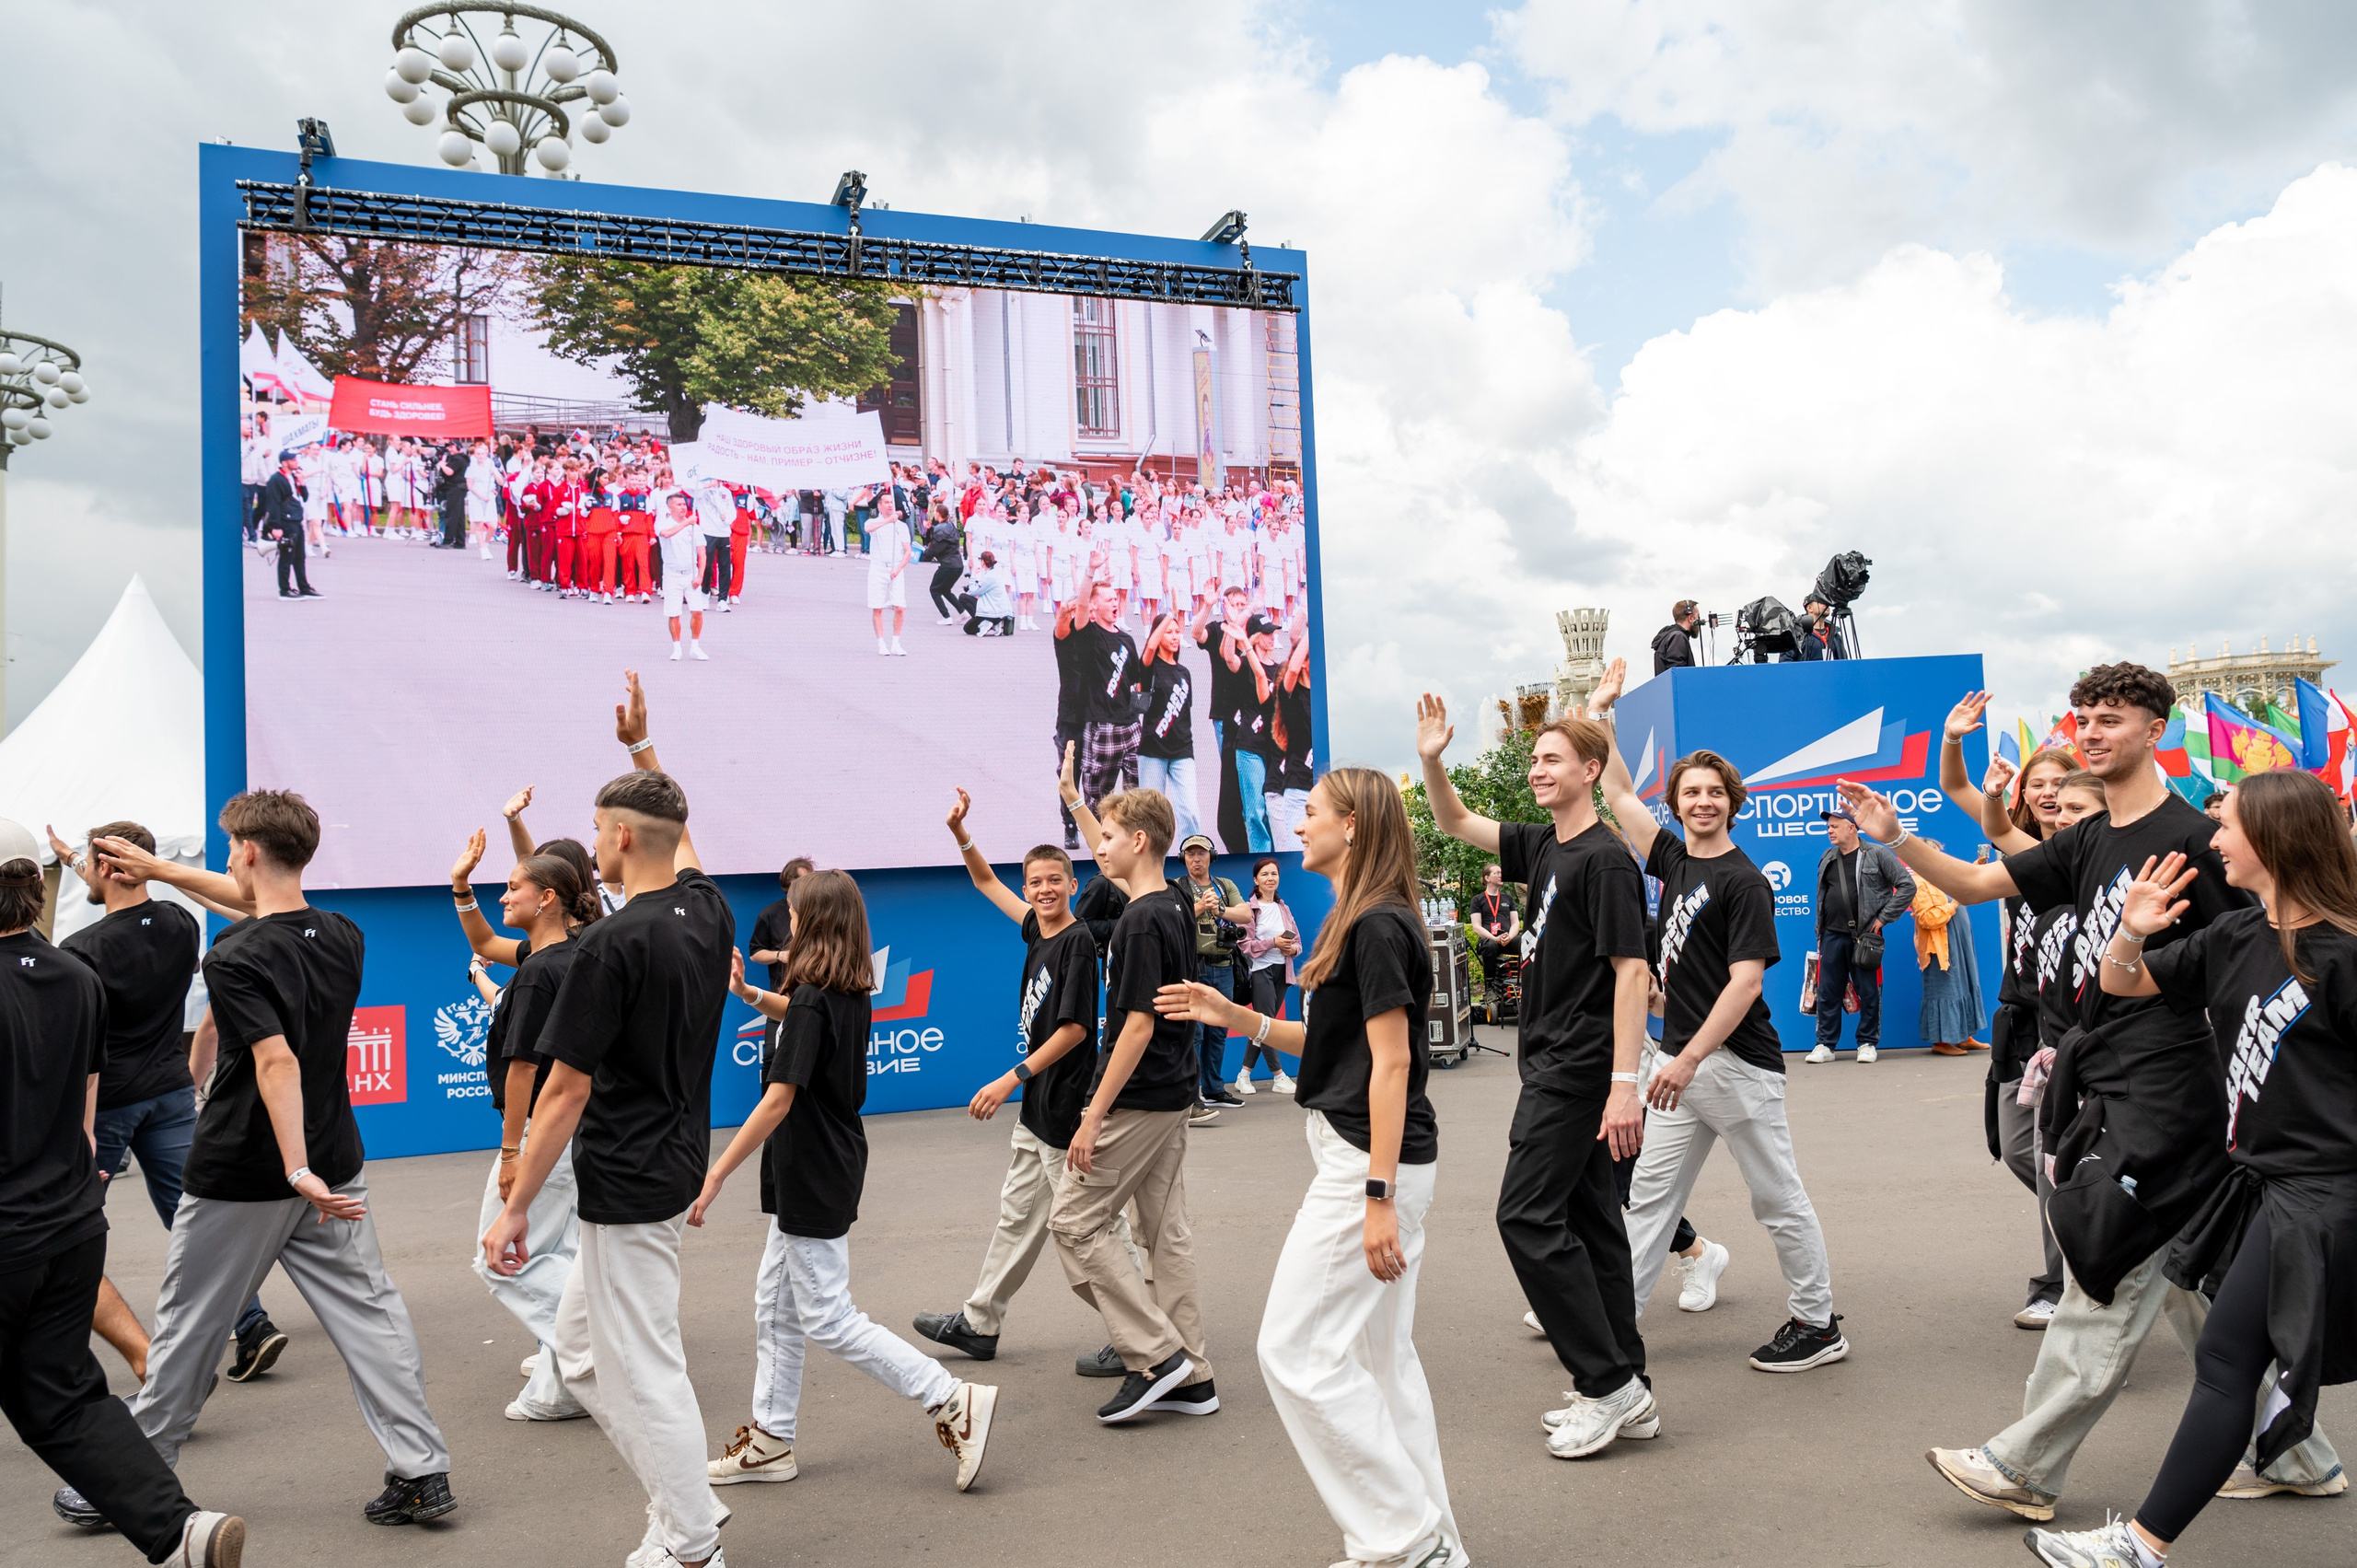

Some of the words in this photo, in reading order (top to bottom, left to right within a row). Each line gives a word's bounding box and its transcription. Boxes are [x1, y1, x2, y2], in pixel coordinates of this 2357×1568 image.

[369, 399, 399, 409] СТАНЬ
[369, 408, 392, 418] БУДЬ
[716, 434, 731, 445] НАШ
[732, 437, 781, 454] ЗДОРОВЫЙ
[823, 440, 862, 453] ЖИЗНИ
[707, 443, 739, 459] РАДОСТЬ
[771, 456, 814, 467] ПРИМЕР
[1670, 884, 1710, 964] TEAM
[305, 928, 316, 937] FT
[20, 957, 36, 967] FT
[2242, 980, 2310, 1102] TEAM
[437, 1071, 488, 1085] МИНСП
[447, 1086, 493, 1098] РОССИ
